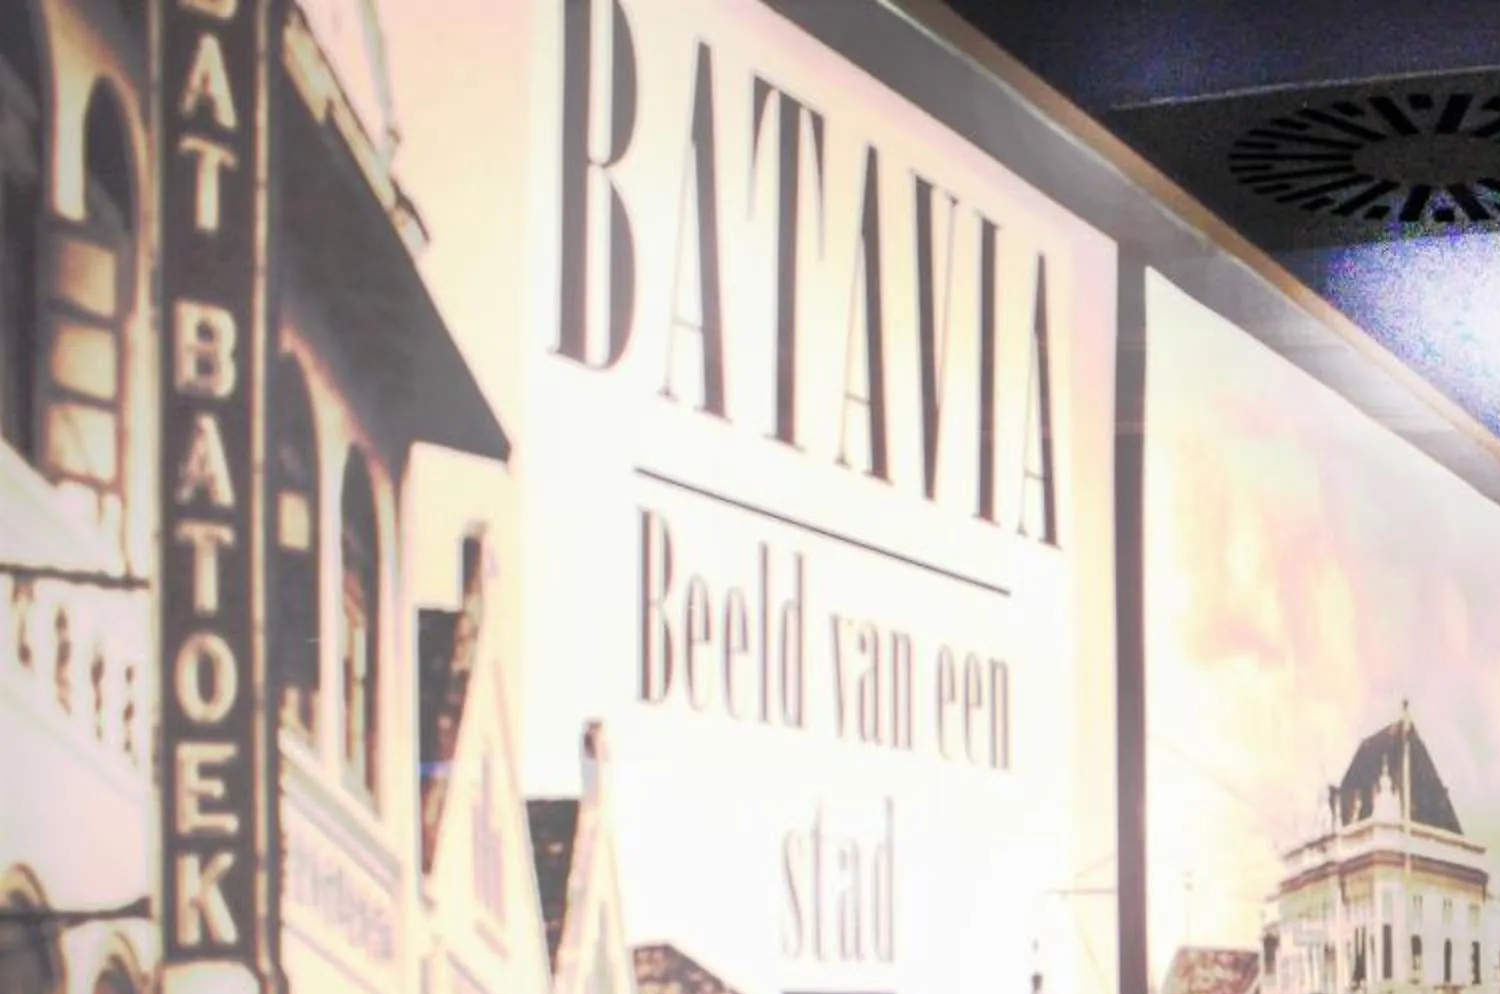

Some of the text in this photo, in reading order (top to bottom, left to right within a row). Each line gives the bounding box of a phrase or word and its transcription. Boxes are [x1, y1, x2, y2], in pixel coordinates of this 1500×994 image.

[548, 0, 1062, 549] BATAVIA
[174, 300, 240, 946] BATOEK
[638, 507, 1010, 771] Beeld van een
[782, 796, 895, 964] stad
